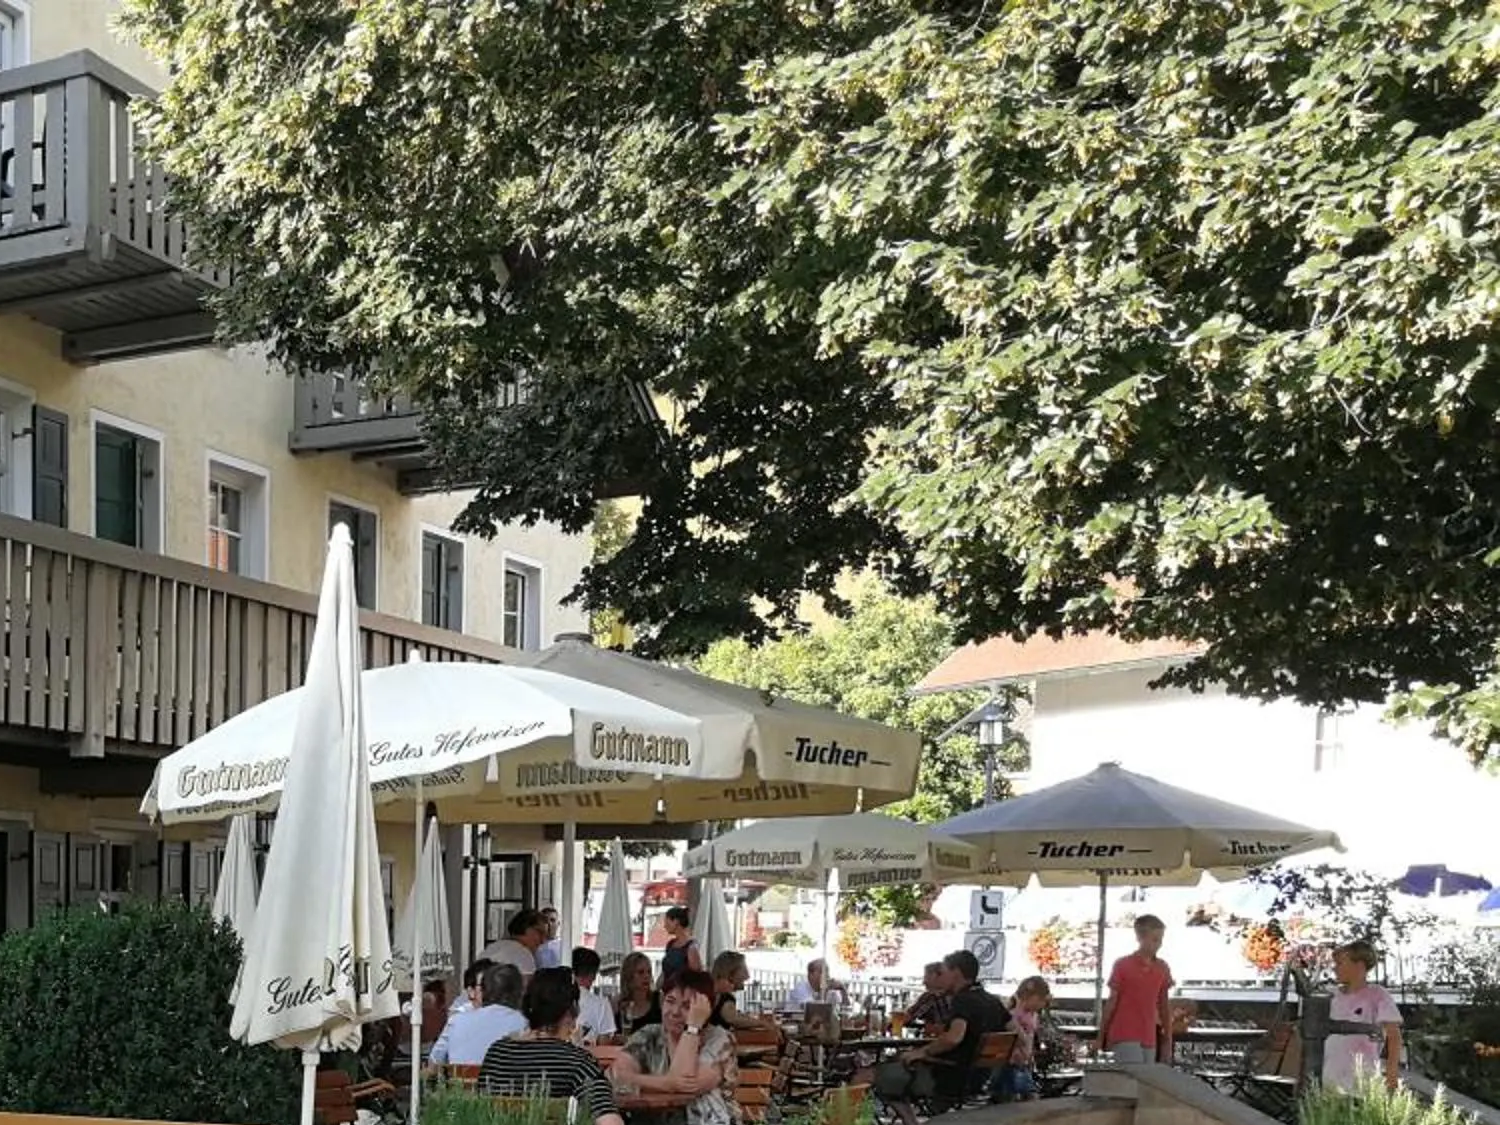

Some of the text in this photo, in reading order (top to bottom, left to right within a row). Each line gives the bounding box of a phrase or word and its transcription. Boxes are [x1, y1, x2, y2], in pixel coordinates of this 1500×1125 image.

[369, 741, 424, 767] Gutes
[590, 721, 691, 767] Gutmann
[795, 737, 869, 768] Tucher
[725, 848, 802, 867] Gutmann
[1038, 841, 1125, 859] Tucher
[1228, 840, 1292, 855] Tucher
